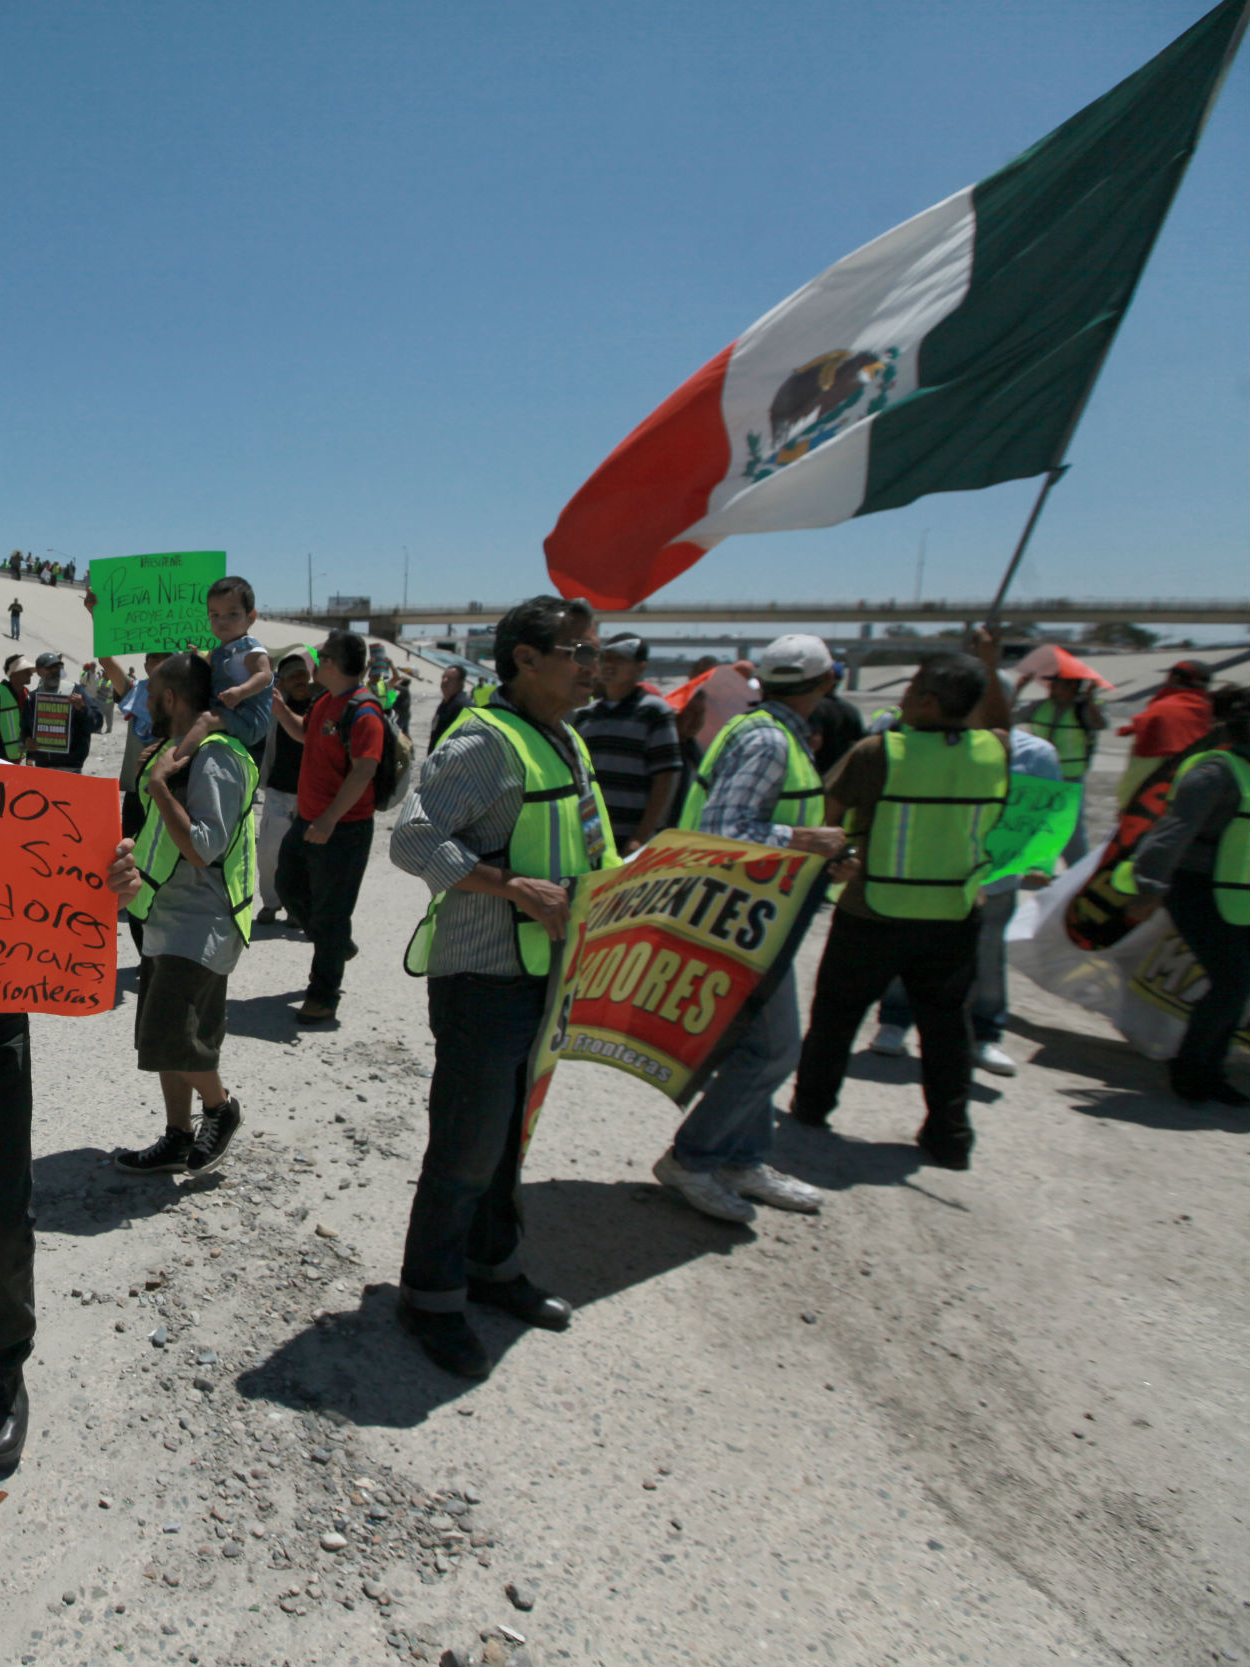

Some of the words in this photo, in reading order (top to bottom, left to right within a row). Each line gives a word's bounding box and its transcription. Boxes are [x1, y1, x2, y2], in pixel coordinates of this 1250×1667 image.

[103, 566, 151, 613] PEÑA
[110, 619, 213, 642] DEPORTADO
[126, 608, 164, 624] APOYE
[166, 609, 175, 619] A
[180, 606, 207, 619] LOS
[121, 642, 151, 655] DEL
[20, 841, 104, 890] Sino
[576, 941, 732, 1035] ADORES
[573, 1034, 673, 1083] Fronteras
